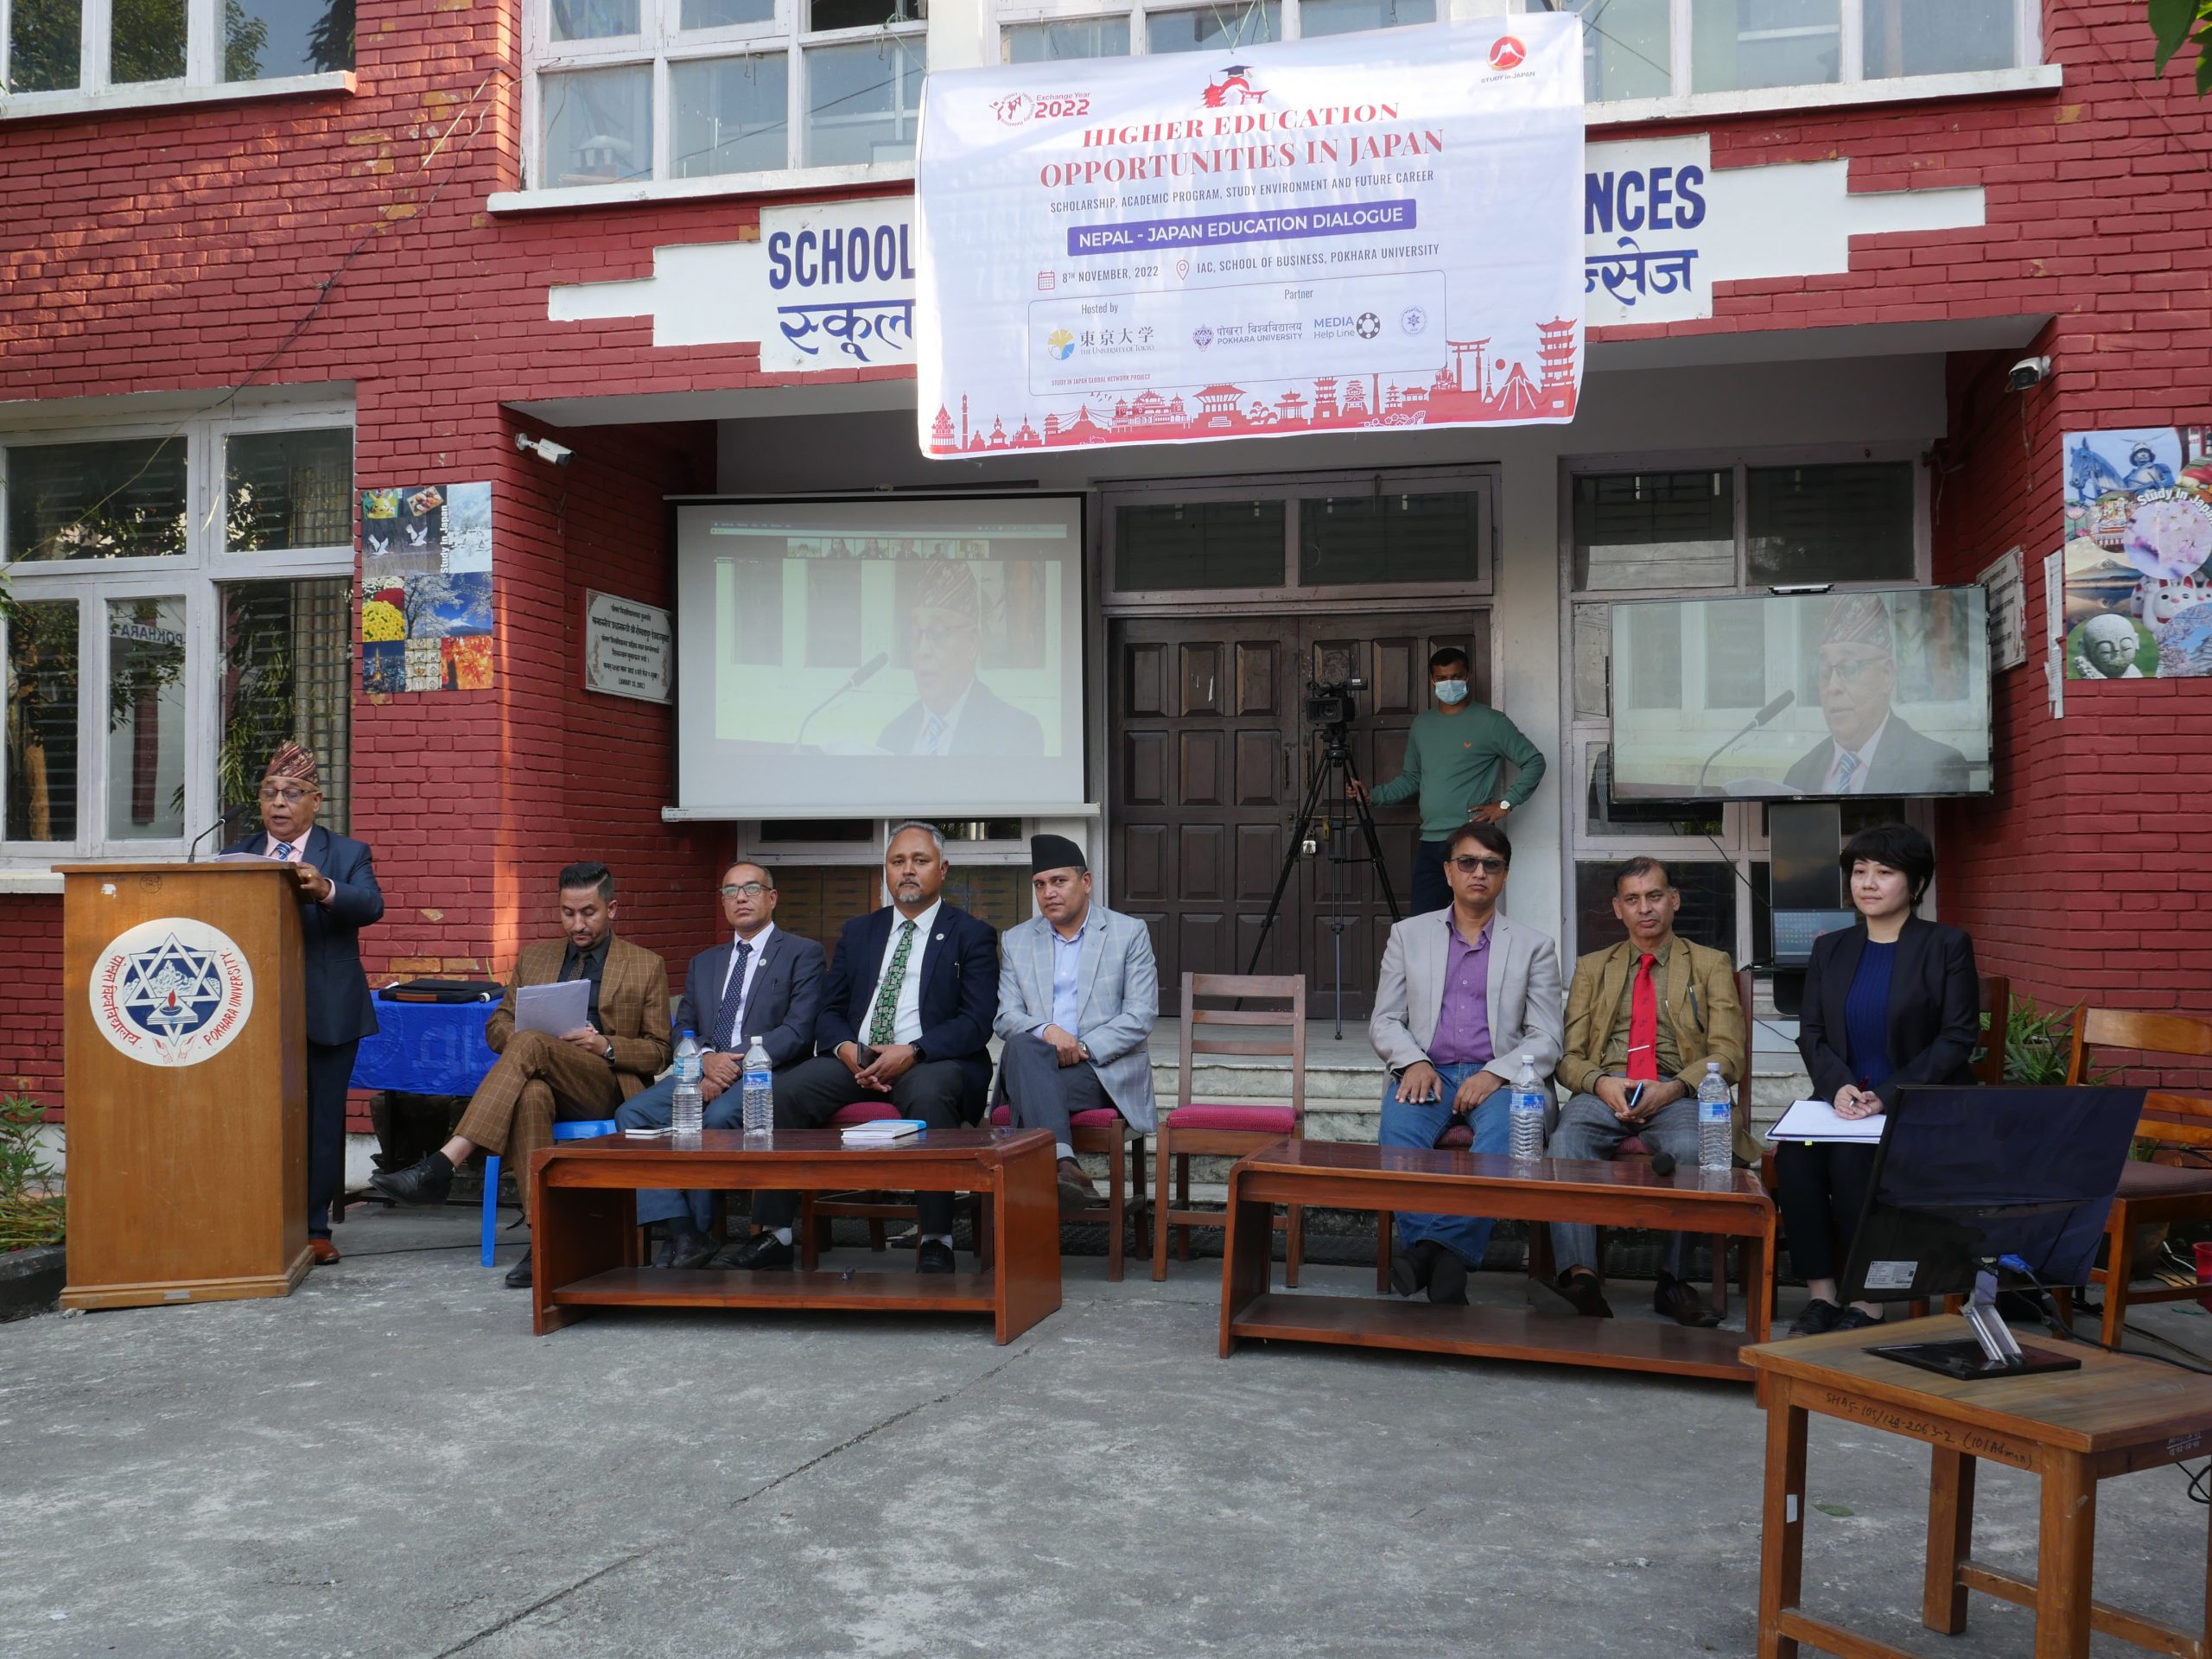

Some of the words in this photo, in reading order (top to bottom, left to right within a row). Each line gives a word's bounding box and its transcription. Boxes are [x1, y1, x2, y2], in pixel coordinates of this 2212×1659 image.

[1480, 74, 1504, 84] STUDY
[1512, 71, 1535, 79] JAPAN
[1036, 92, 1072, 101] Exchange
[1035, 99, 1090, 118] 2022
[1082, 119, 1204, 148] HIGHER
[1213, 102, 1400, 137] EDUCATION
[1039, 142, 1297, 188] OPPORTUNITIES
[1306, 138, 1338, 165] IN
[1348, 129, 1444, 167] JAPAN
[1050, 197, 1118, 213] SCHOLARSHIP,
[1121, 192, 1170, 207] ACADEMIC
[1173, 188, 1223, 203] PROGRAM,
[1225, 184, 1256, 199] STUDY
[1260, 179, 1328, 195] ENVIRONMENT
[1332, 177, 1351, 189] AND
[1355, 173, 1393, 188] FUTURE
[1395, 169, 1434, 184] CAREER
[1079, 231, 1134, 249] NEPAL
[1147, 224, 1203, 243] JAPAN
[1207, 215, 1307, 238] EDUCATION
[1313, 207, 1403, 229] DIALOGUE
[767, 223, 916, 290] SCHOOL
[1197, 262, 1216, 274] IAC,
[1219, 256, 1258, 272] SCHOOL
[1261, 256, 1273, 269] OF
[1276, 252, 1328, 268] BUSINESS,
[1331, 248, 1377, 264] POKHARA
[1381, 243, 1440, 259] UNIVERSITY
[1078, 268, 1131, 283] NOVEMBER,
[1135, 265, 1159, 278] 2022
[1284, 289, 1313, 300] Partner
[1081, 302, 1108, 315] Hosted
[1109, 302, 1118, 315] by
[777, 298, 917, 362] स्कूल
[1217, 325, 1243, 337] पोखरा
[1248, 321, 1303, 335] विश्वविद्यालय
[1313, 316, 1355, 328] MEDIA
[1079, 325, 1154, 346] 東京大学
[1217, 334, 1255, 345] POKHARA
[1256, 332, 1303, 342] UNIVERSITY
[1313, 330, 1335, 340] Help
[1336, 328, 1356, 338] Line
[1088, 376, 1107, 385] GLOBAL
[2136, 487, 2173, 506] Study
[2176, 487, 2189, 501] in
[439, 505, 450, 534] Japan
[440, 547, 450, 574] Study
[219, 951, 244, 1007] UNIVERSITY
[203, 1007, 241, 1046] POKHARA
